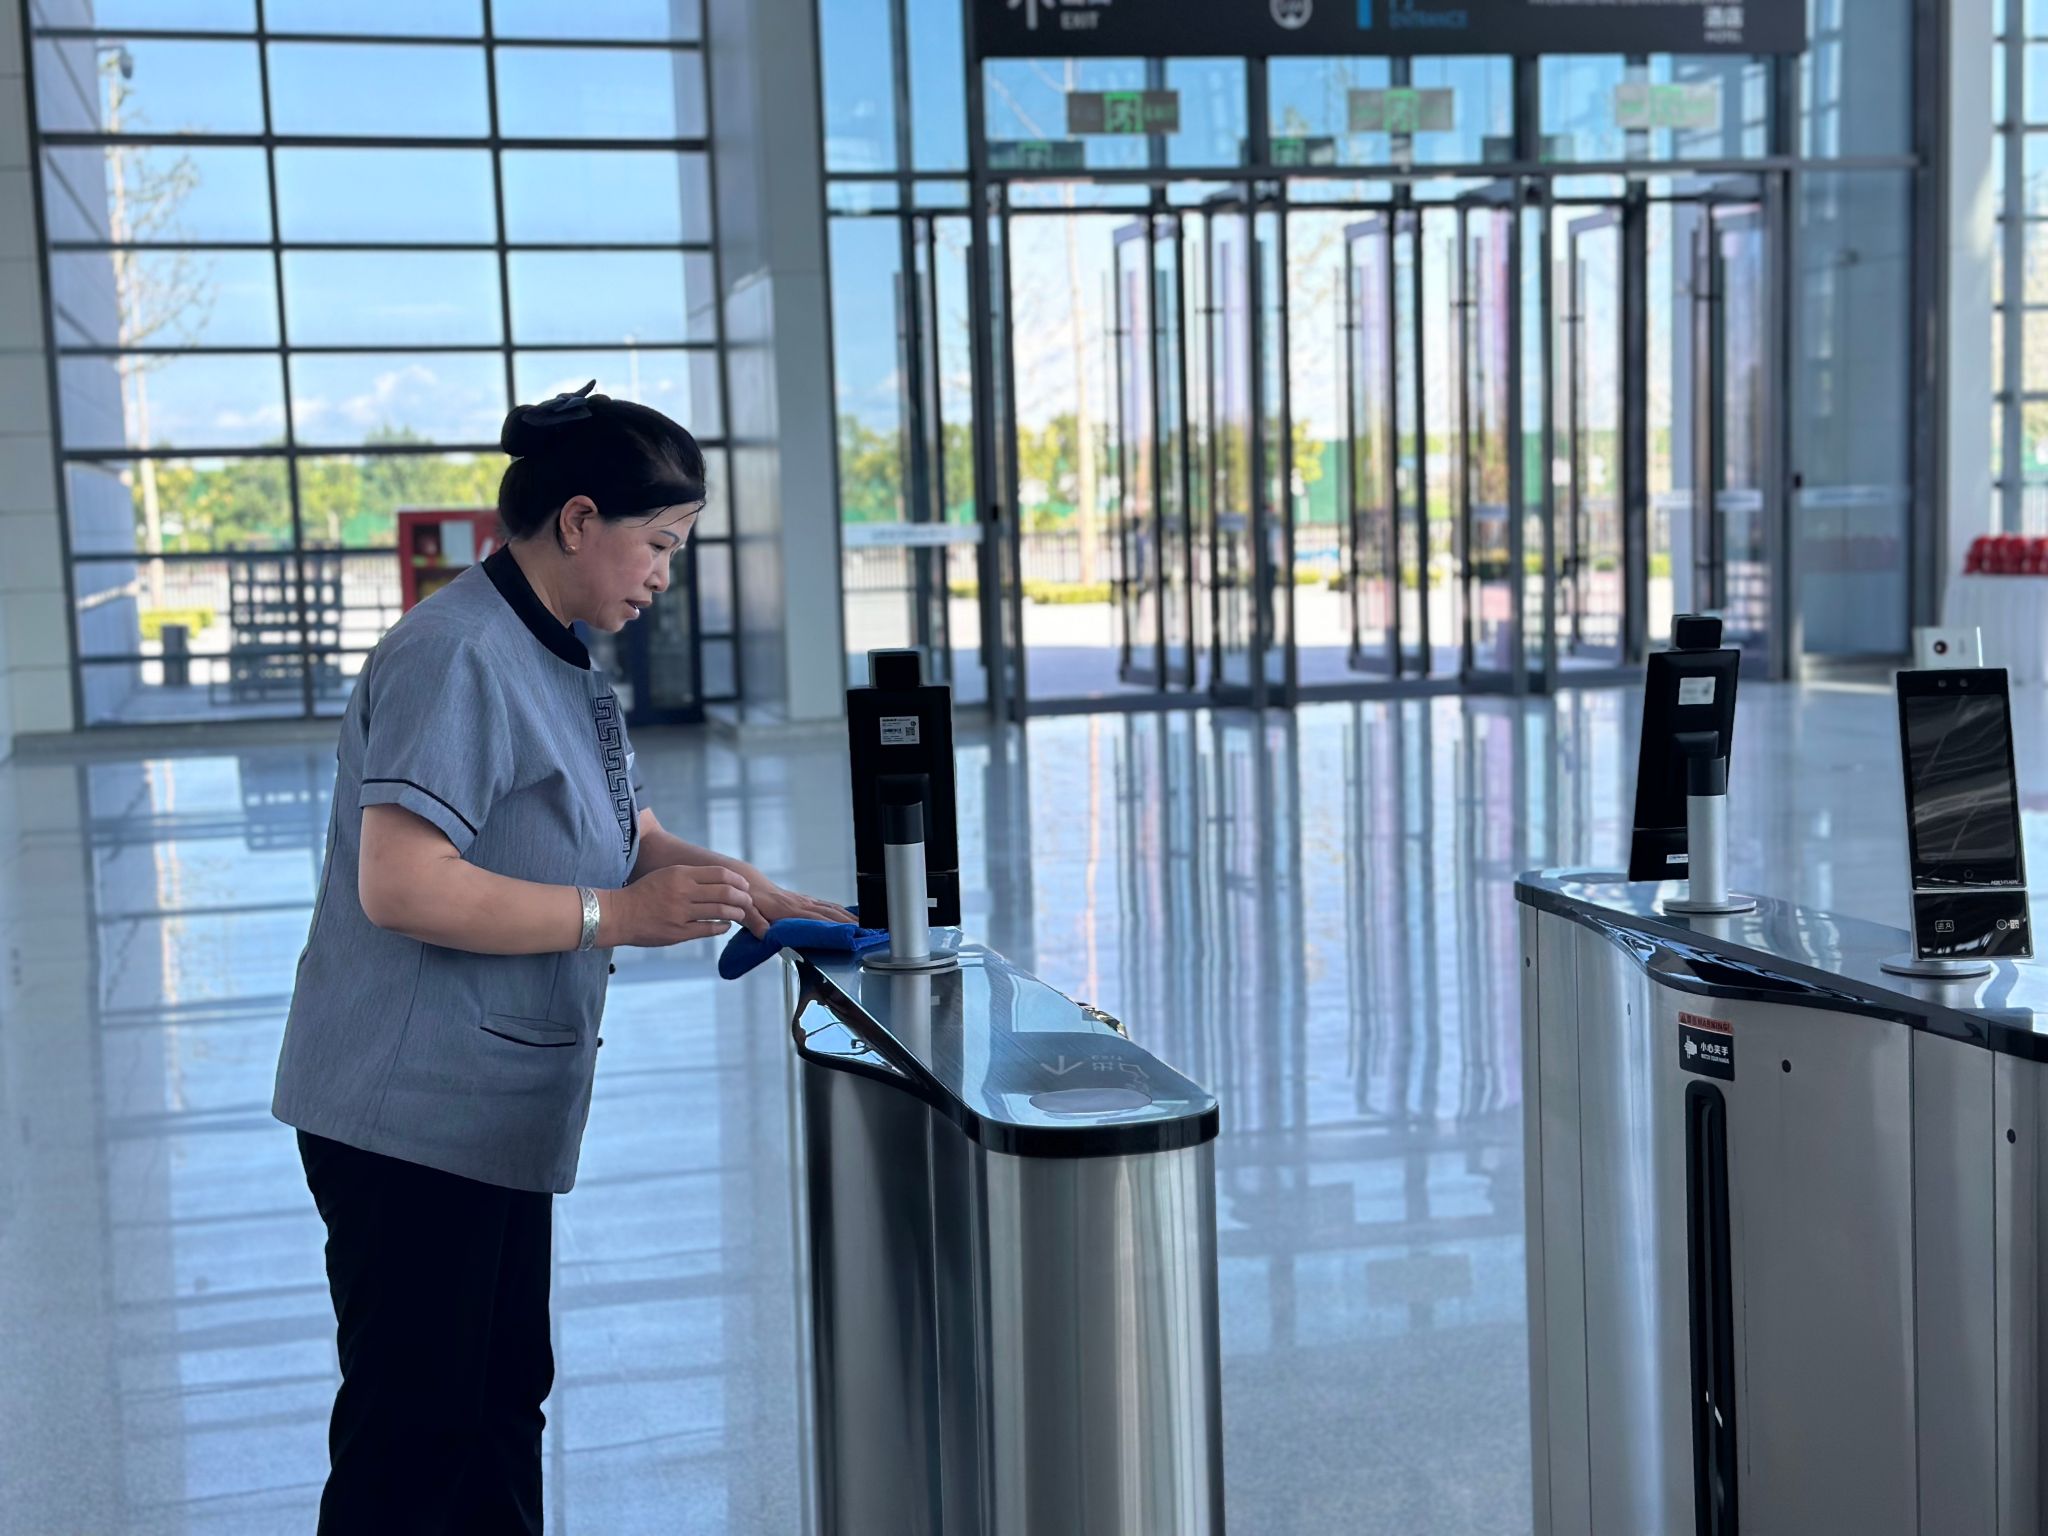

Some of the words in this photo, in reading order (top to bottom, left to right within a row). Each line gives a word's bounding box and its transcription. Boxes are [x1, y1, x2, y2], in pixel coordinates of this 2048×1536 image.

[1060, 11, 1098, 30] EXIT
[1701, 1042, 1729, 1056] 小心夹手
